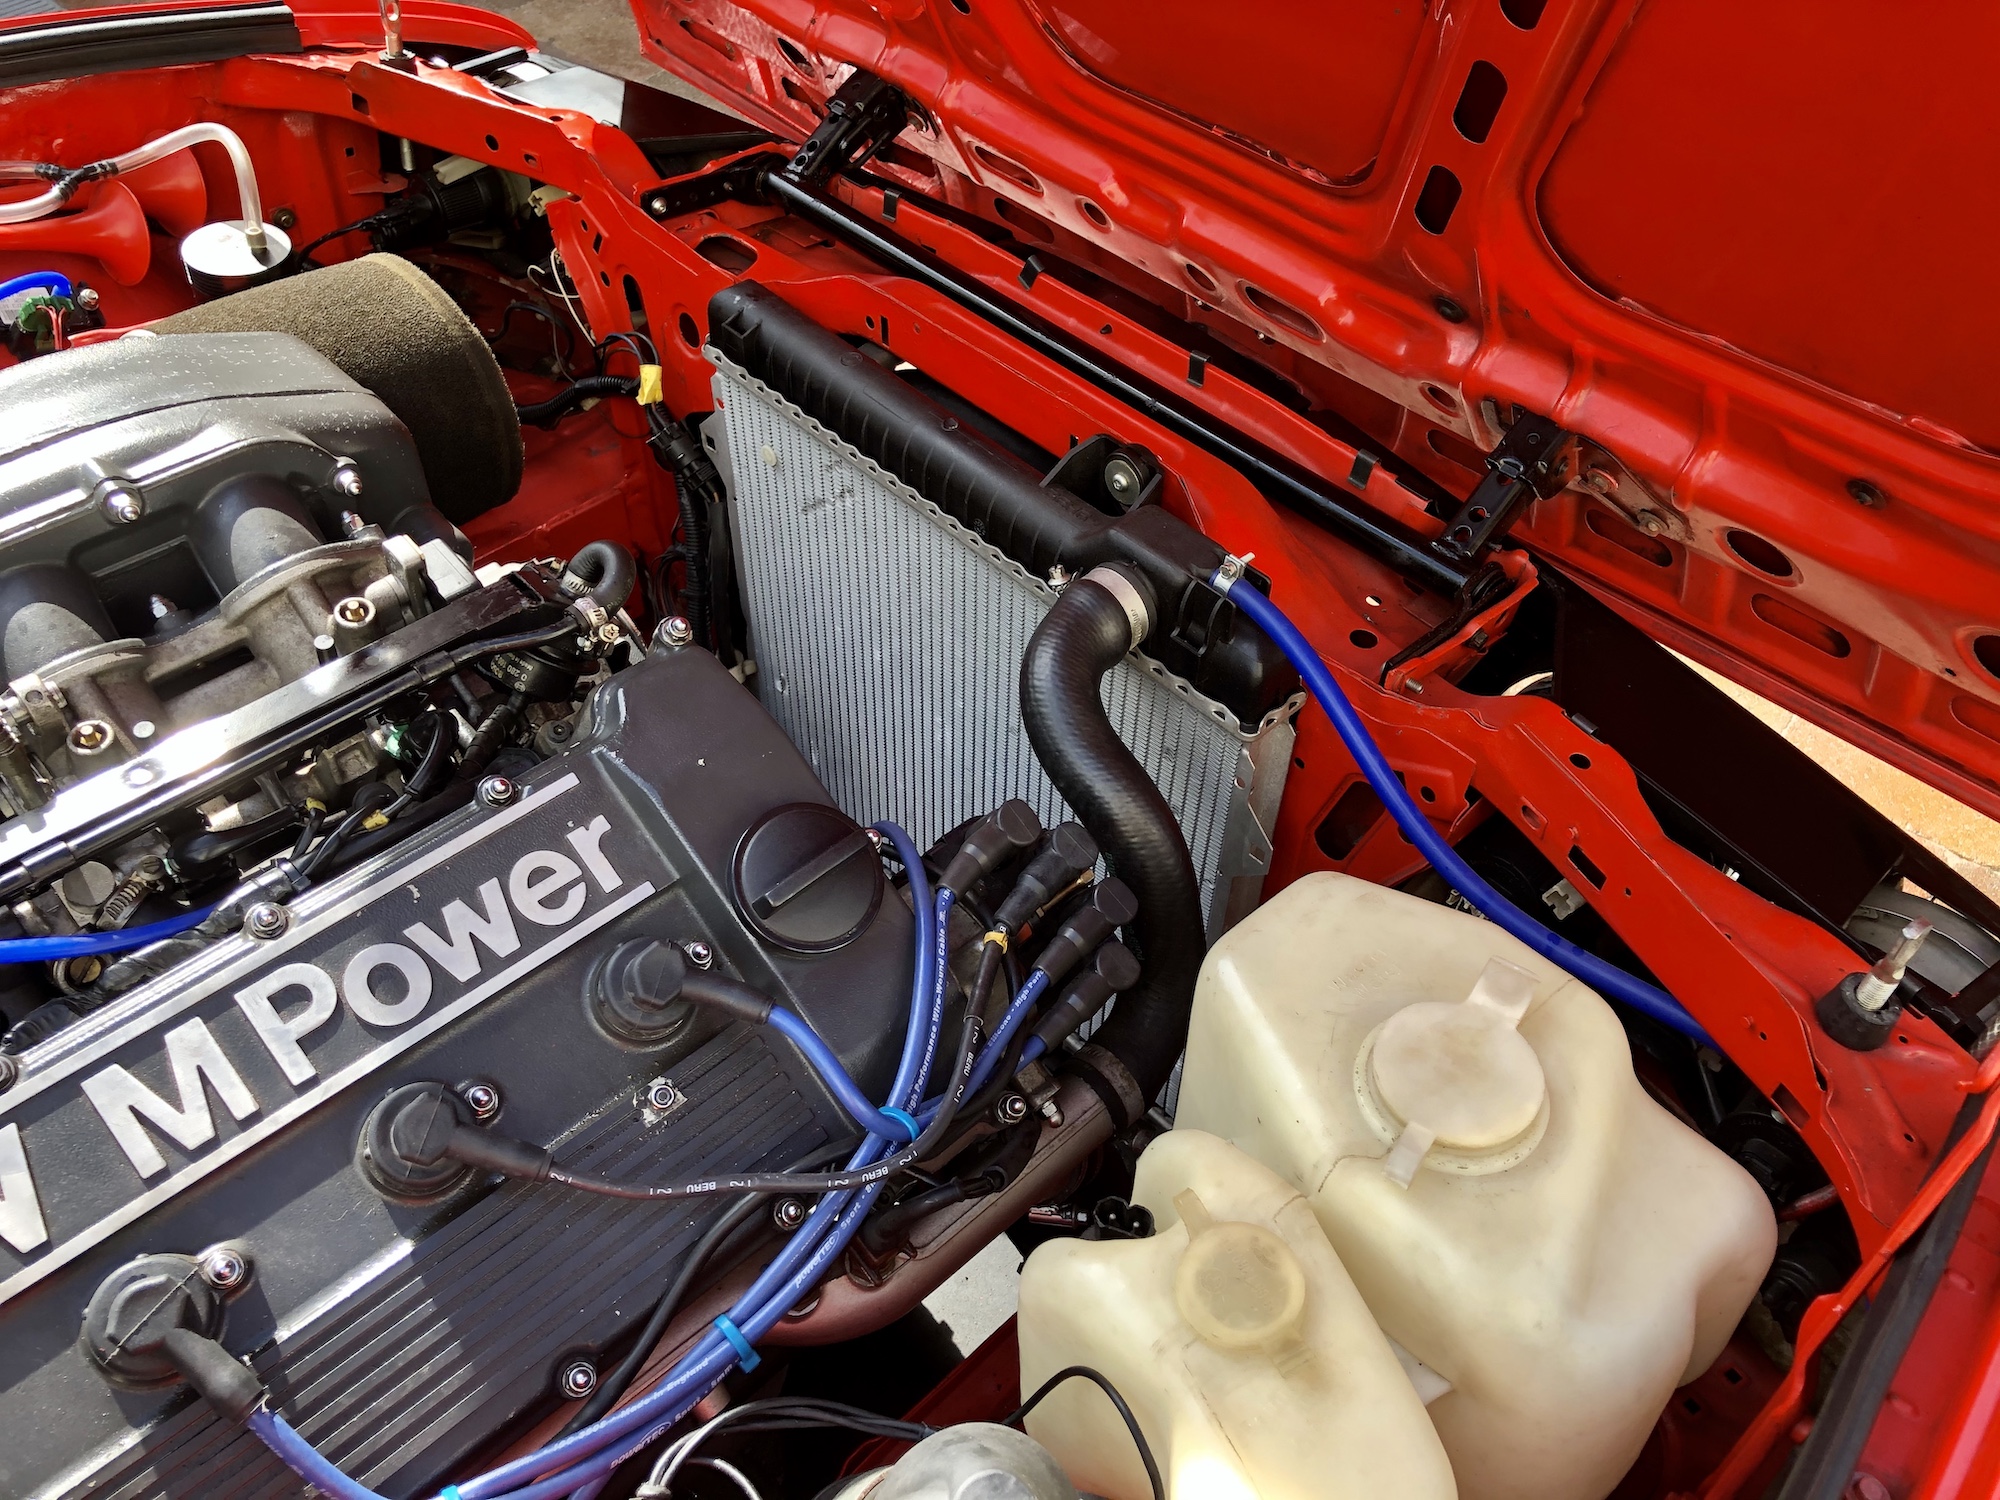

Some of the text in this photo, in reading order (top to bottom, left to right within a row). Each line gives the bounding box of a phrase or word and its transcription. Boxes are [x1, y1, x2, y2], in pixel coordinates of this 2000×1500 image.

[80, 814, 624, 1180] M Power
[914, 1024, 938, 1092] Performance
[938, 928, 946, 956] Cable
[1014, 989, 1029, 1008] High
[963, 1051, 974, 1077] BERU
[686, 1181, 716, 1193] BERU
[861, 1166, 889, 1182] BERU
[840, 1202, 861, 1230] Sport
[666, 1358, 709, 1392] England
[674, 1396, 702, 1423] Sport
